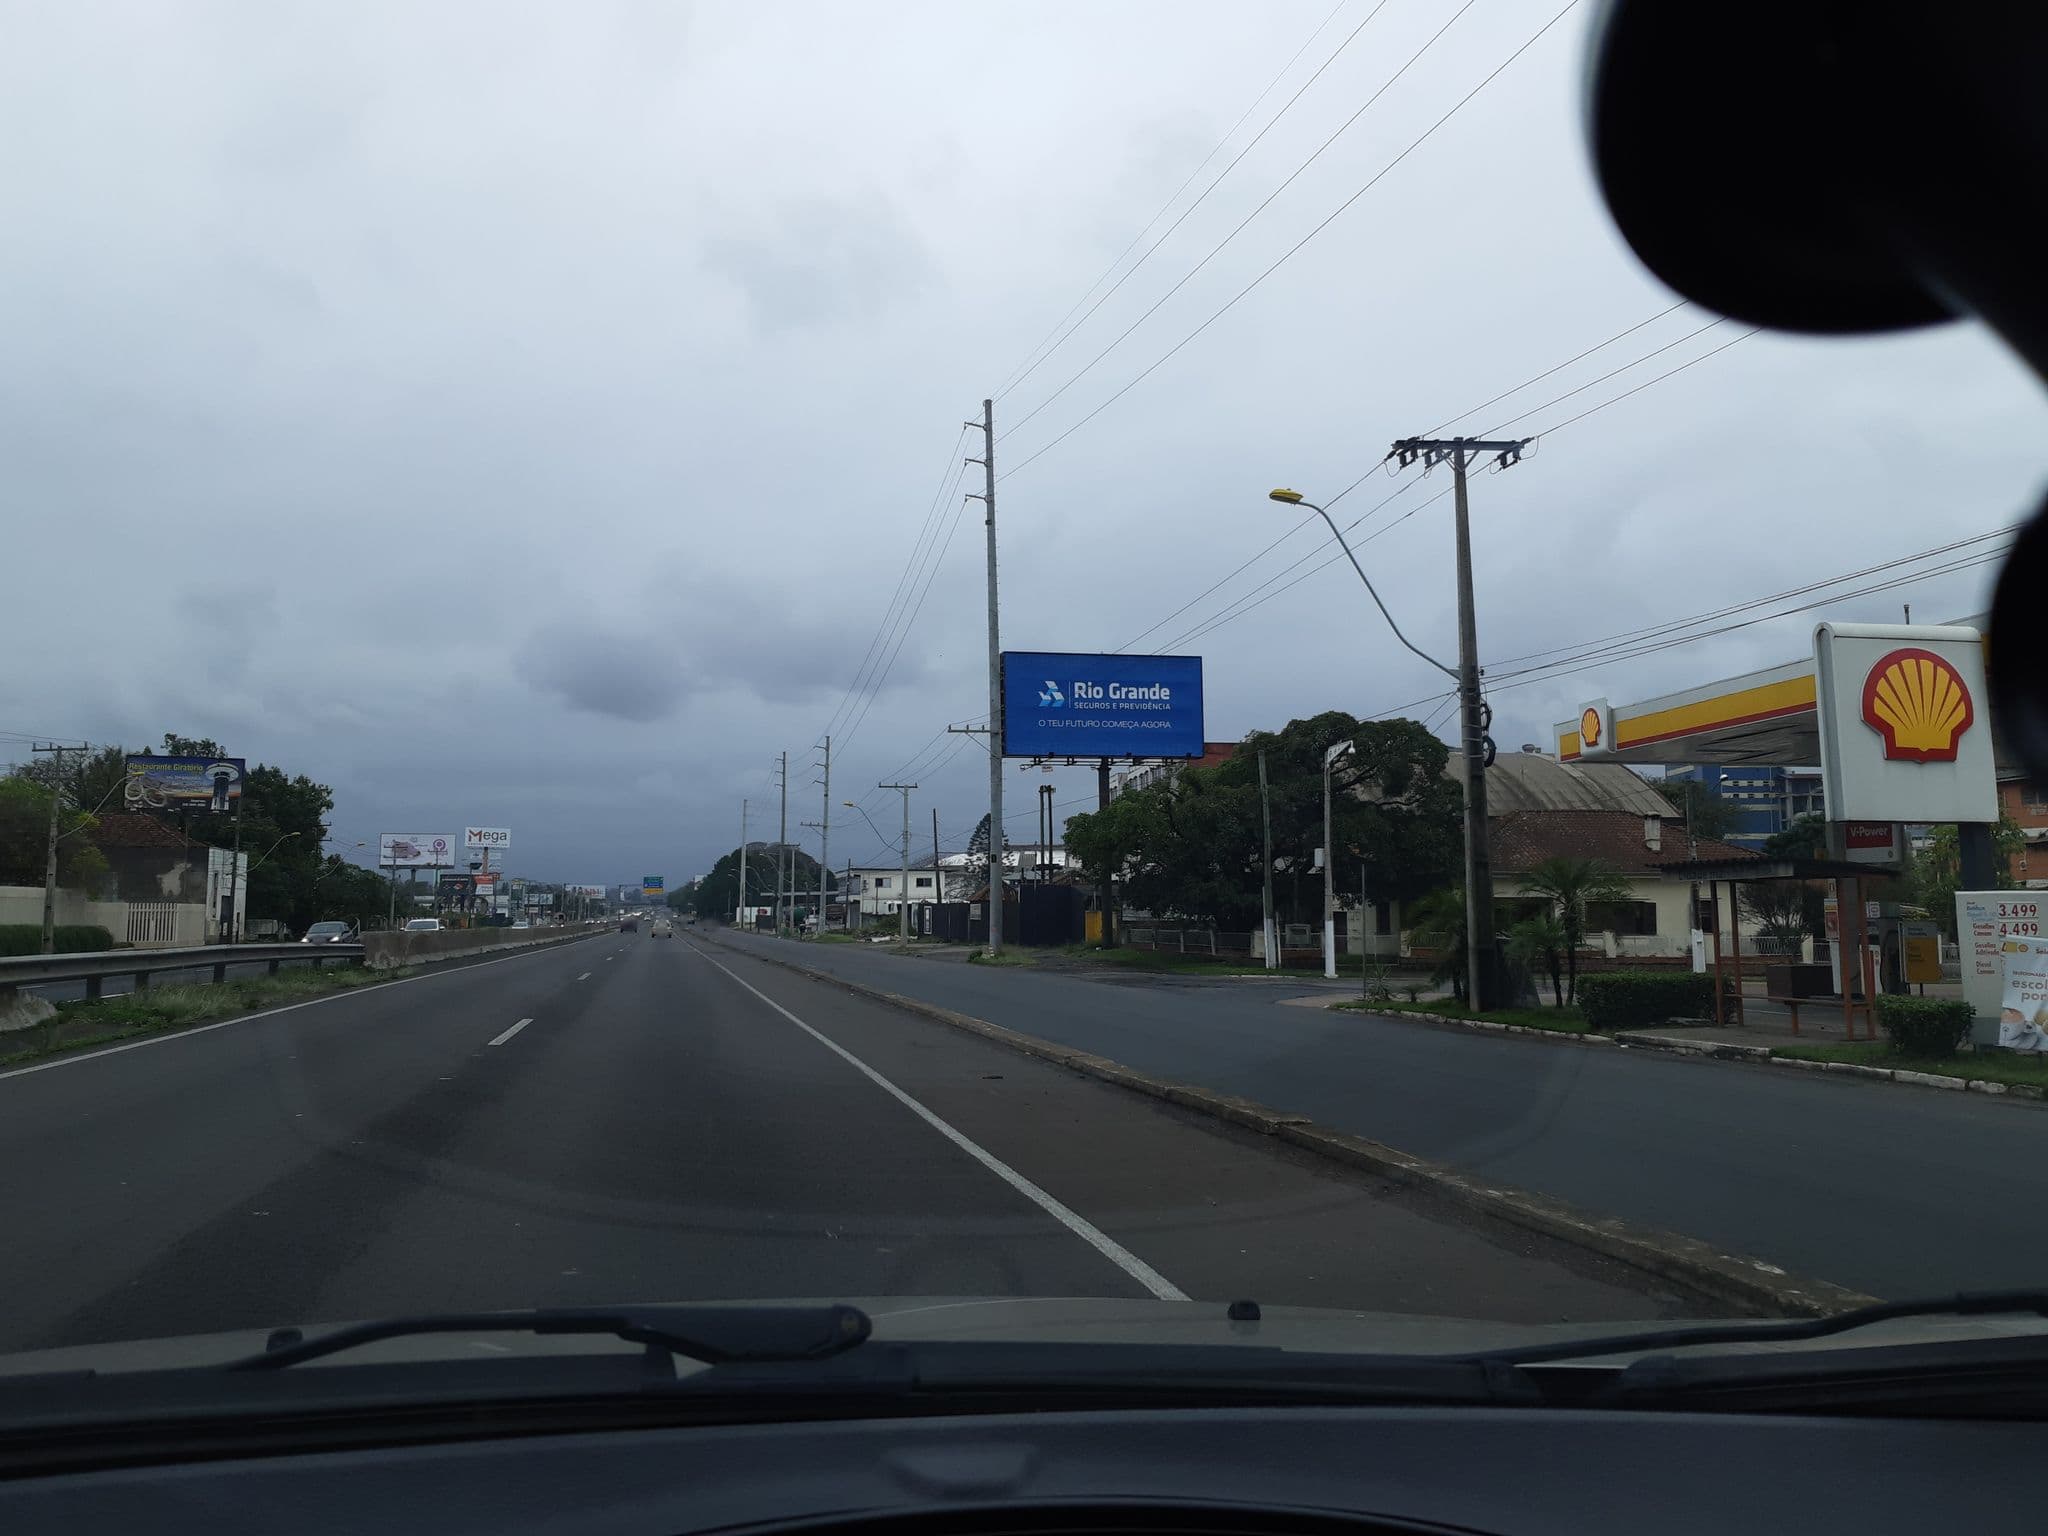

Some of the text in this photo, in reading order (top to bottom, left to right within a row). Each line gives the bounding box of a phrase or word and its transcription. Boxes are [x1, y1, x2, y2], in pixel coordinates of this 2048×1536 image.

[1074, 681, 1170, 700] Rio Grande
[1074, 701, 1171, 711] SEGUROS E PREVIDÊNCIA
[1038, 719, 1172, 729] O TEU FUTURO COMEÇA AGORA
[468, 829, 508, 843] Mega
[1998, 904, 2037, 917] 3.499
[1999, 922, 2039, 936] 4.499
